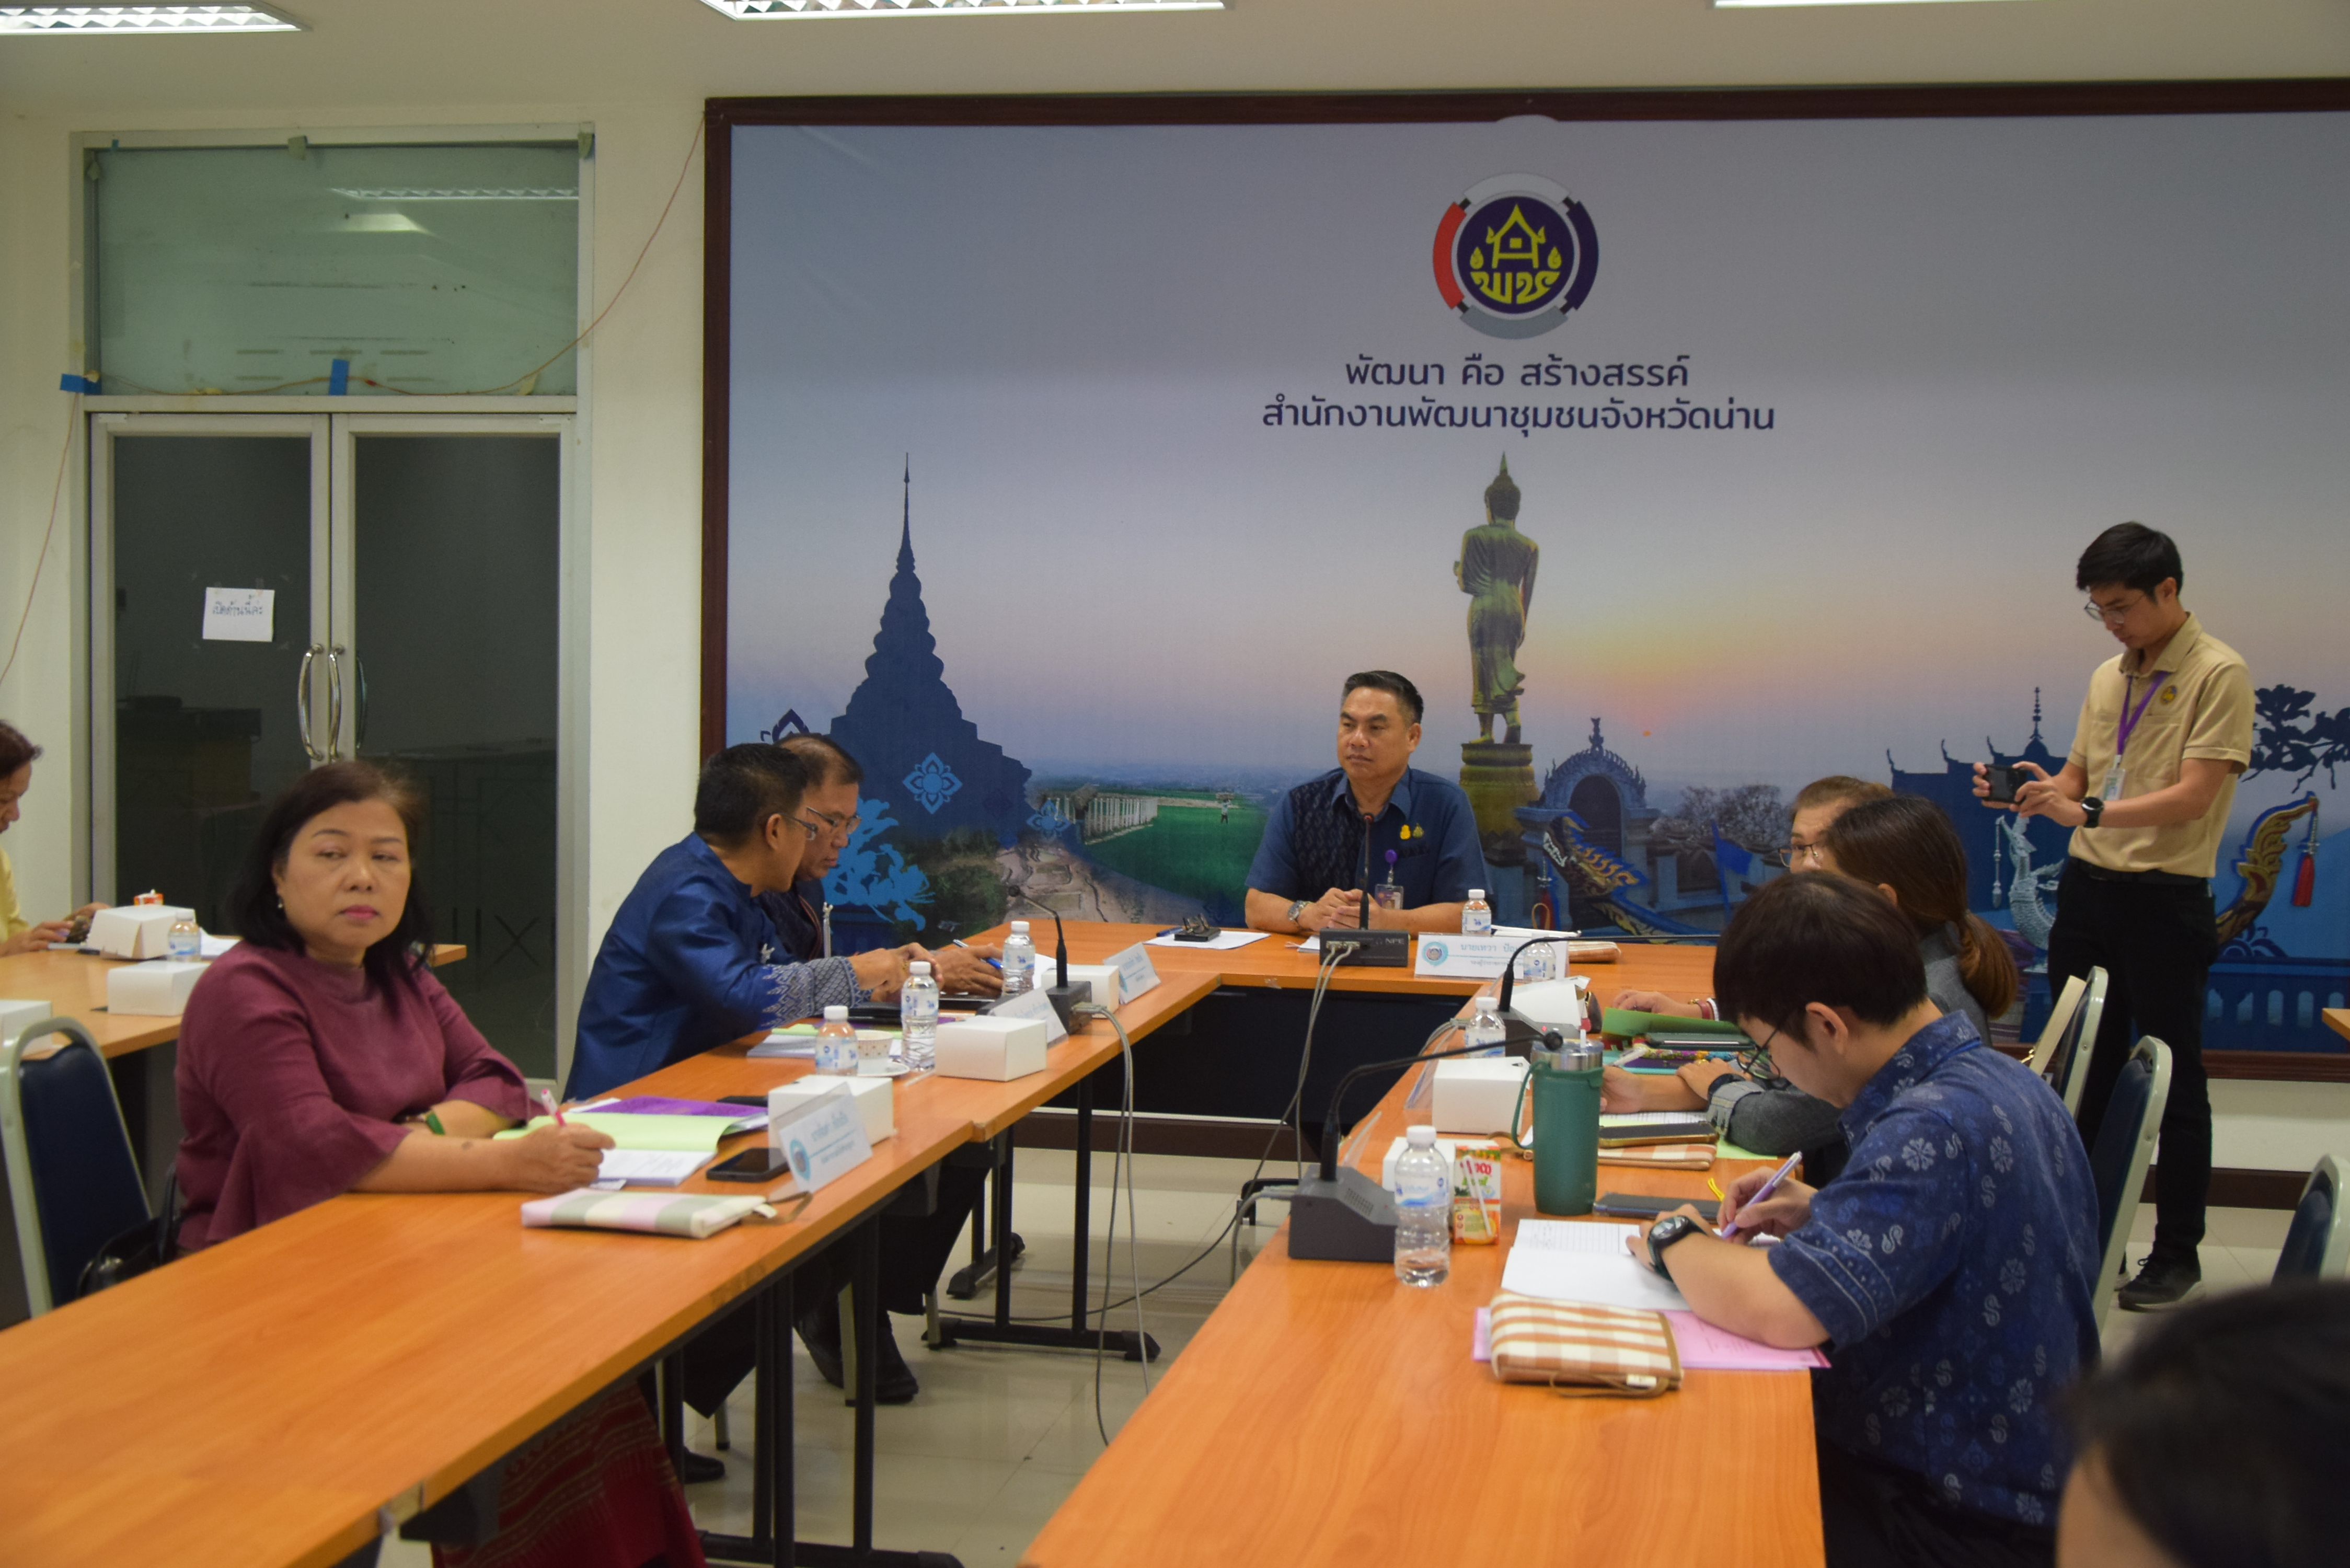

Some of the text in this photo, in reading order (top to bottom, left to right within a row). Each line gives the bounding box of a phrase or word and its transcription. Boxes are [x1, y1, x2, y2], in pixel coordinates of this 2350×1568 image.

[1345, 353, 1690, 387] พัฒนา คือ สร้างสรรค์
[1263, 393, 1775, 437] สำนักงานพัฒนาชุมชนจังหวัดน่าน
